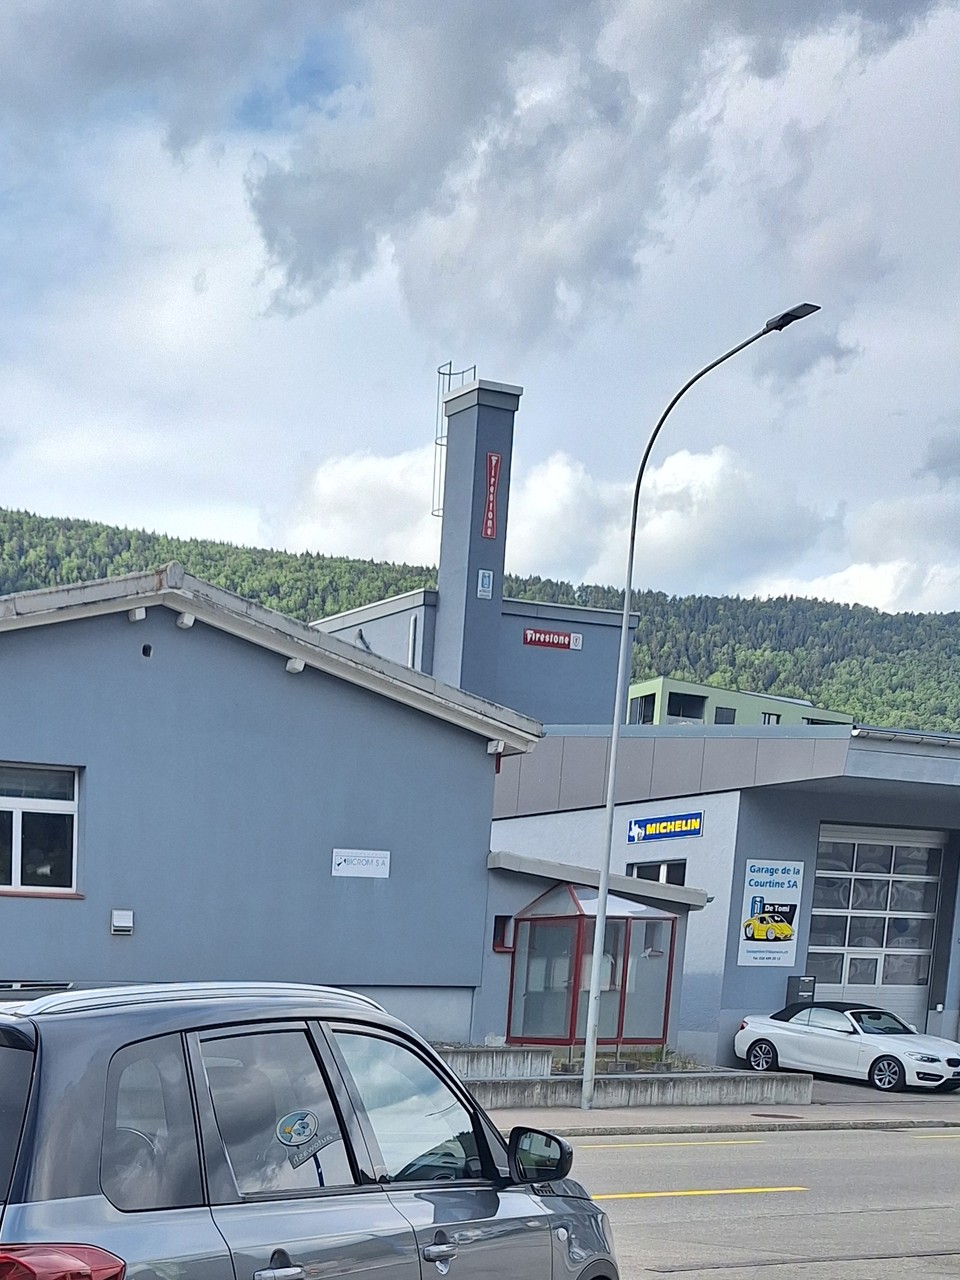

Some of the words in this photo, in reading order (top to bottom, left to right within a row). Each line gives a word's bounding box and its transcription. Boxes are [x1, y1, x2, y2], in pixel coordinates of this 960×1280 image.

[487, 456, 498, 536] Firestone
[526, 629, 570, 645] Firestone
[646, 818, 700, 835] MICHELIN
[749, 865, 780, 877] Garage
[781, 866, 792, 875] de
[793, 866, 801, 876] la
[748, 878, 786, 889] Courtine
[786, 879, 798, 889] SA
[765, 904, 774, 912] De
